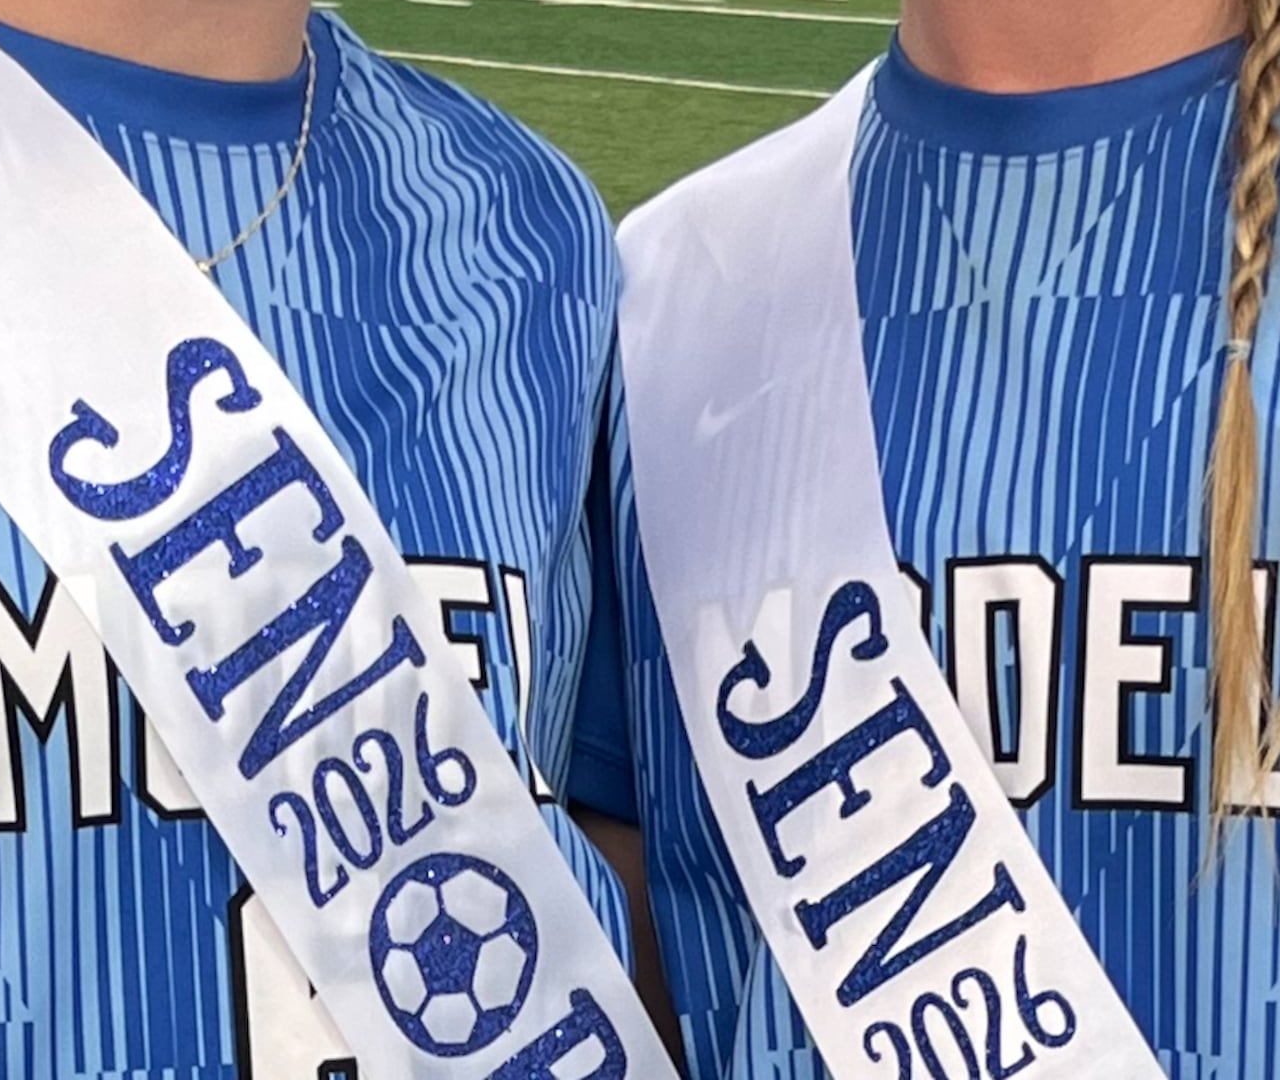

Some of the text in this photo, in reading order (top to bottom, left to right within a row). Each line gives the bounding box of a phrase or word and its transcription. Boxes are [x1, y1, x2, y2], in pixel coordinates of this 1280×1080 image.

[49, 337, 426, 781] SEN
[269, 691, 477, 910] 2026
[716, 580, 1026, 1008] SEN
